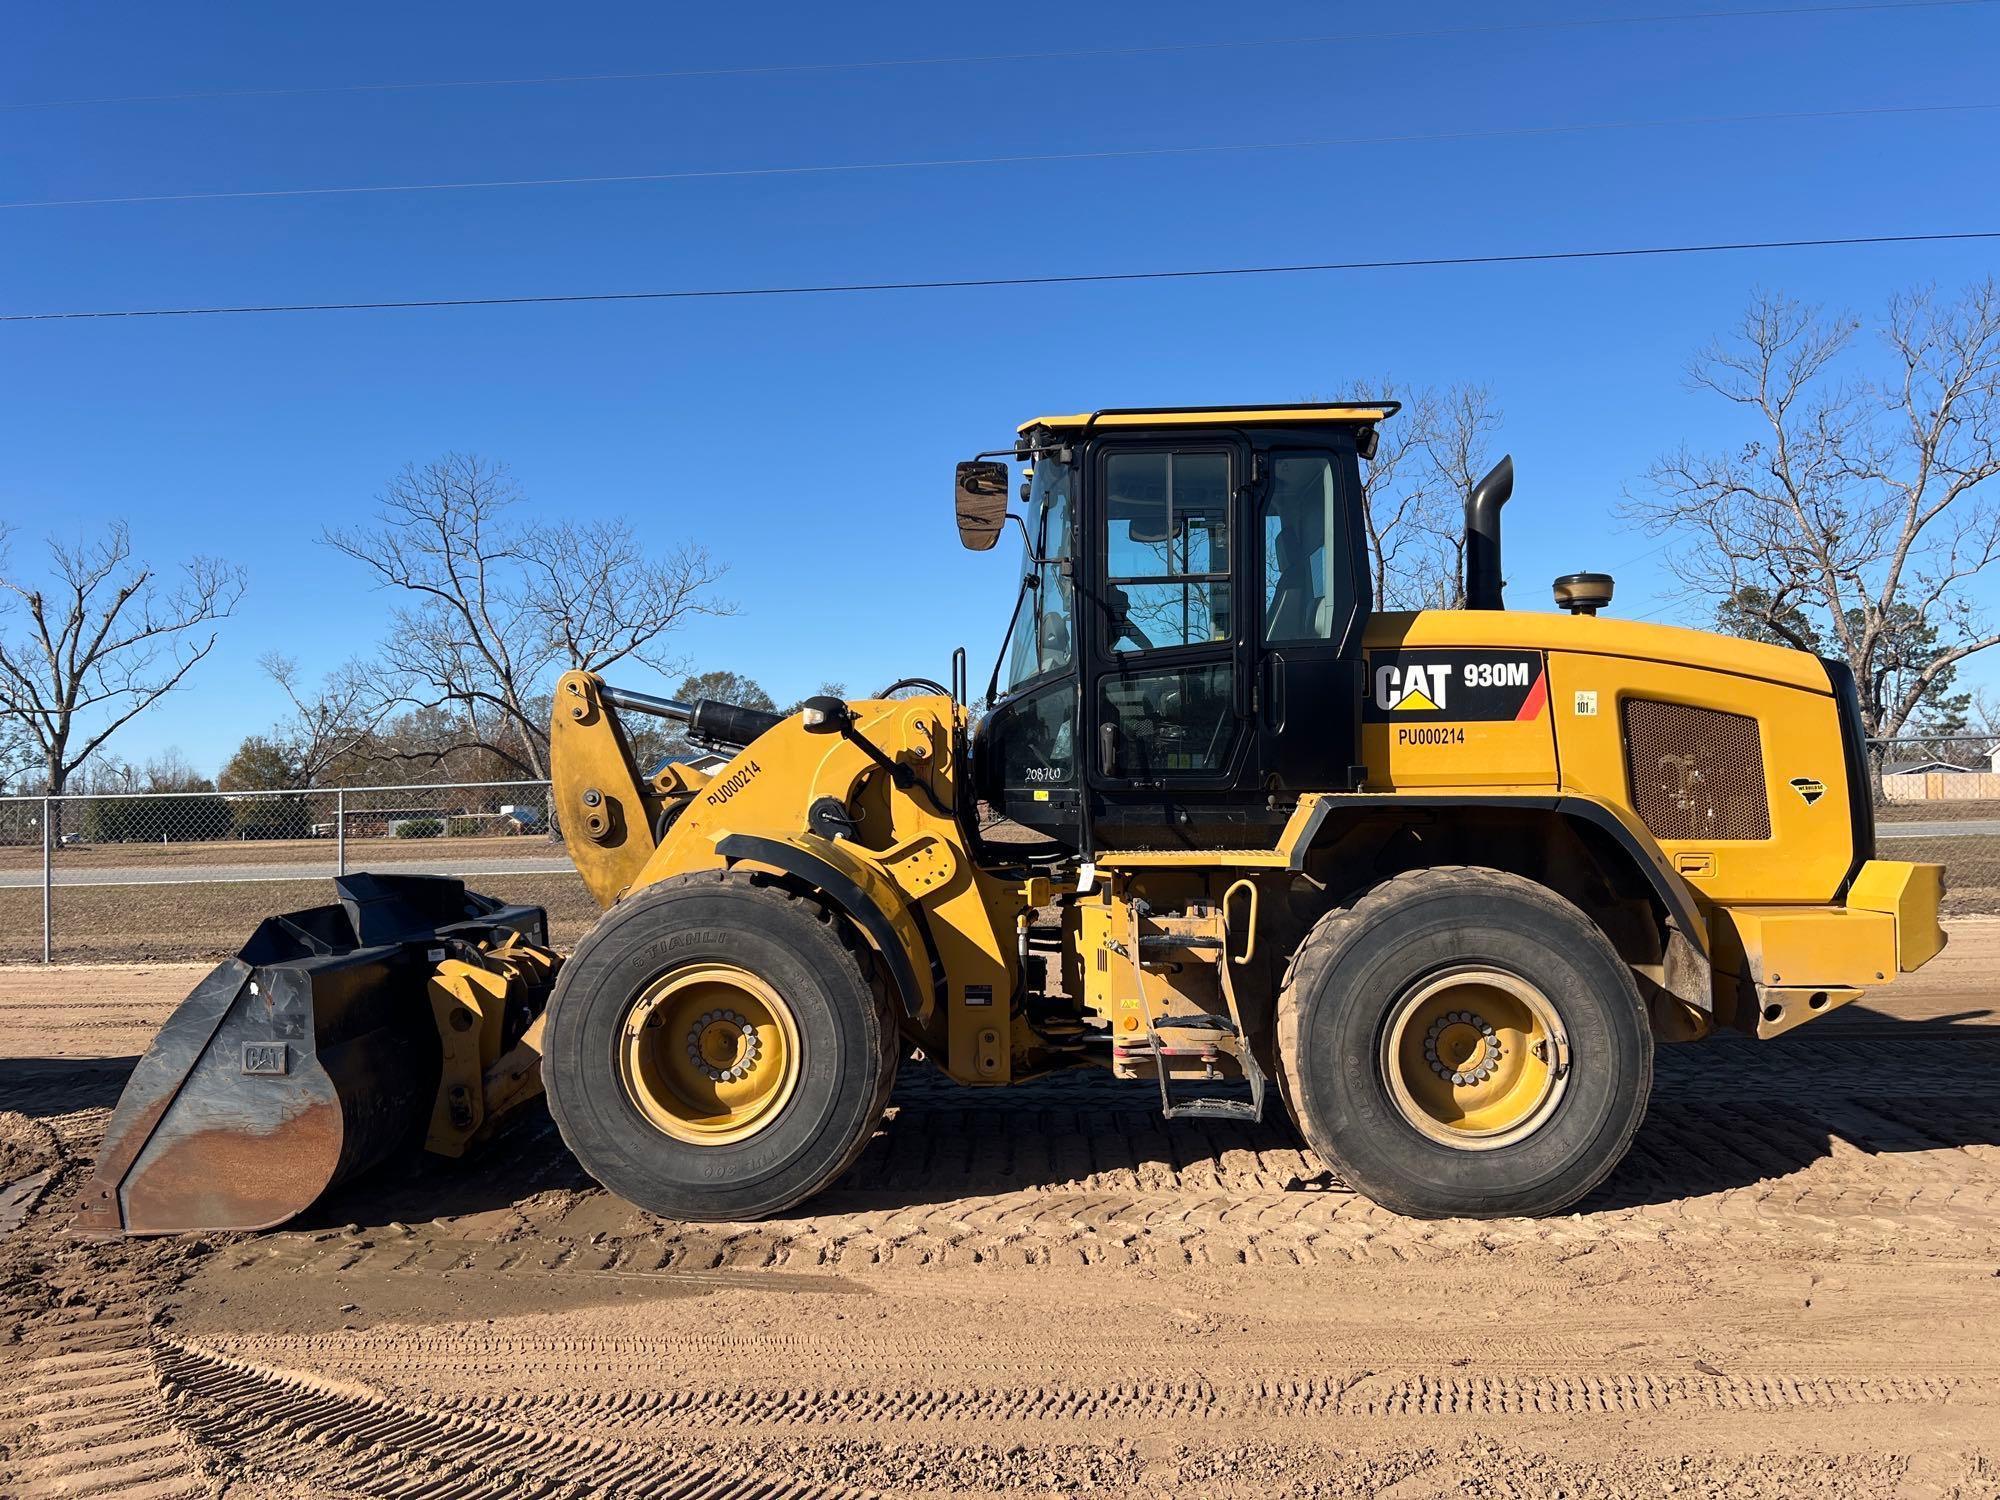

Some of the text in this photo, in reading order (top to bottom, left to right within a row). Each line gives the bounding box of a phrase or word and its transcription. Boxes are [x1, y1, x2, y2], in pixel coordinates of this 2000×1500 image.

[1375, 662, 1529, 711] CAT 930M
[1577, 701, 1589, 713] 101
[1399, 727, 1465, 746] PU000214
[707, 760, 761, 806] PU000214
[645, 931, 727, 959] TIANLI
[246, 1047, 283, 1072] CAT
